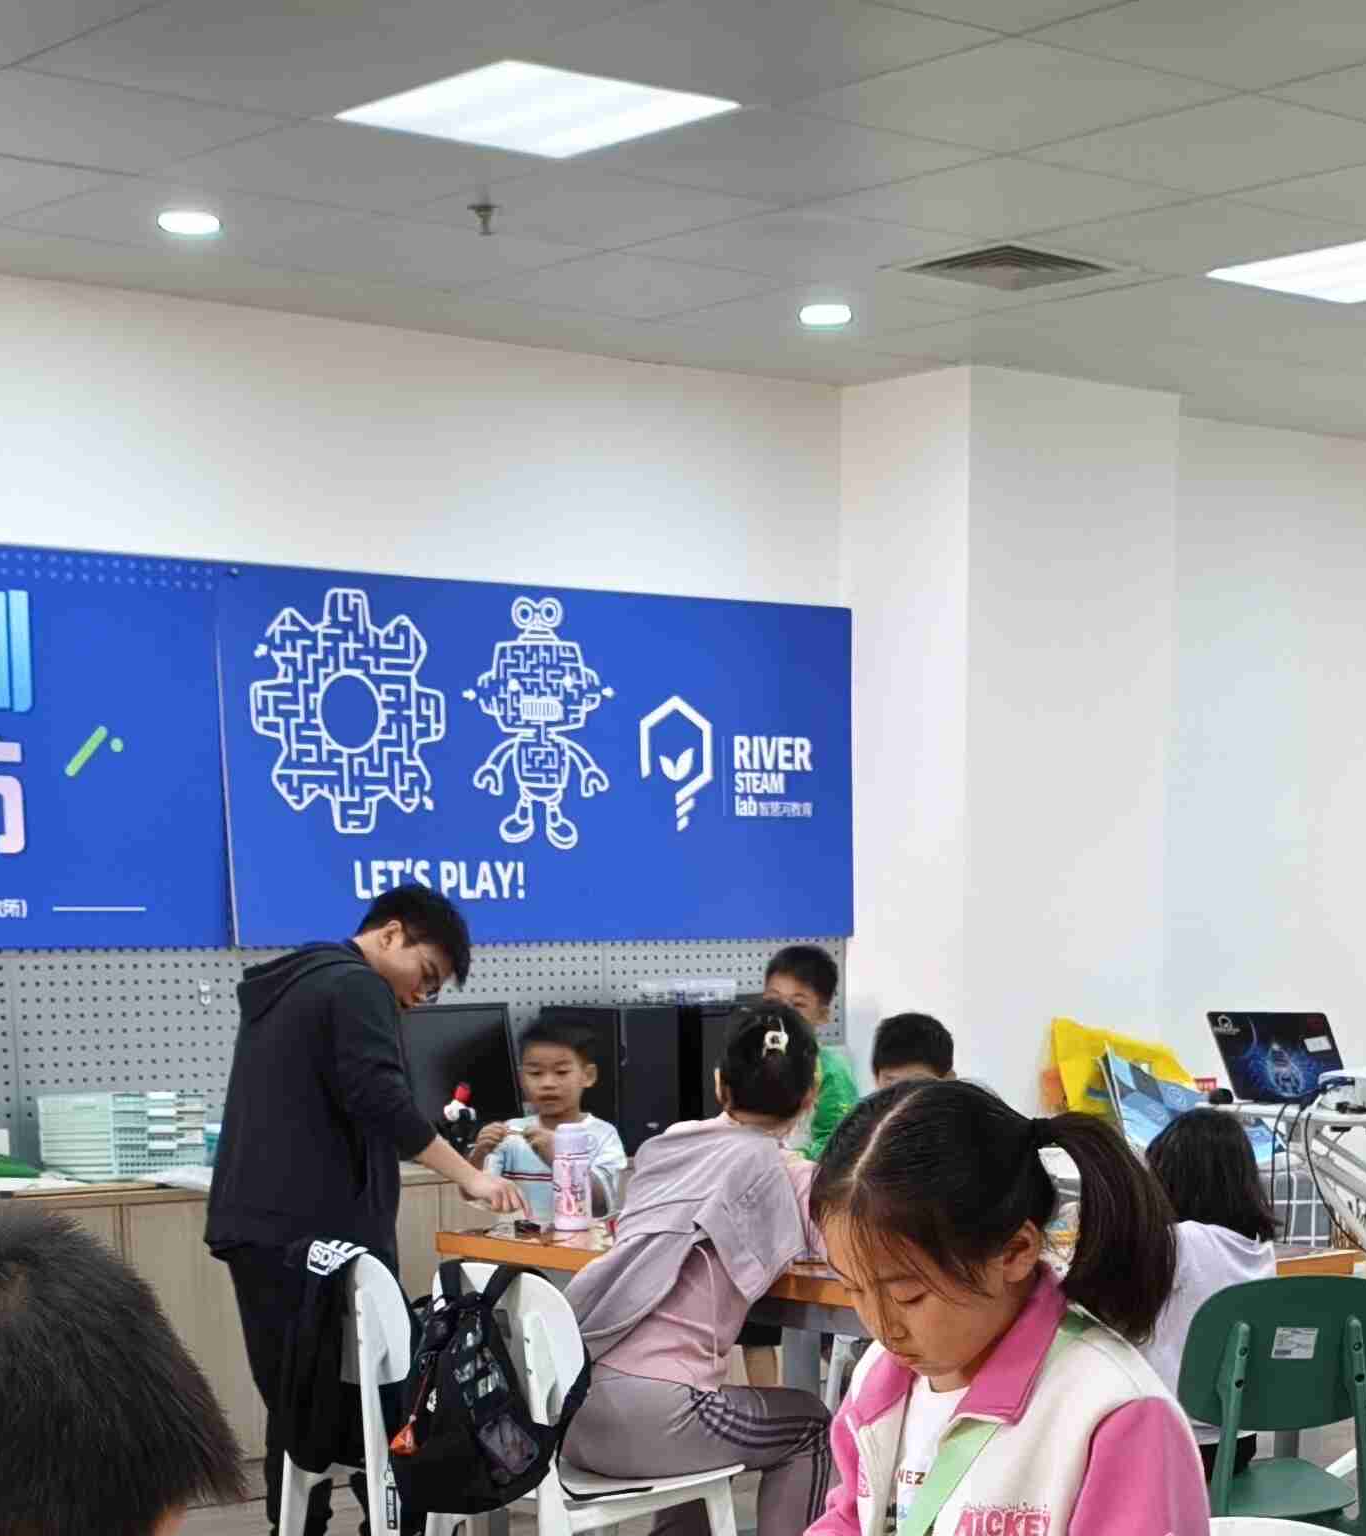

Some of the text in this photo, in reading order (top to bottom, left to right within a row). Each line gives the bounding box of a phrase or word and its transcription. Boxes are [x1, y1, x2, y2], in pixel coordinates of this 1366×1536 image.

[734, 735, 813, 771] RIVER
[735, 772, 785, 794] STEAM
[735, 795, 757, 817] lab
[353, 857, 526, 900] LET'S PLAY!
